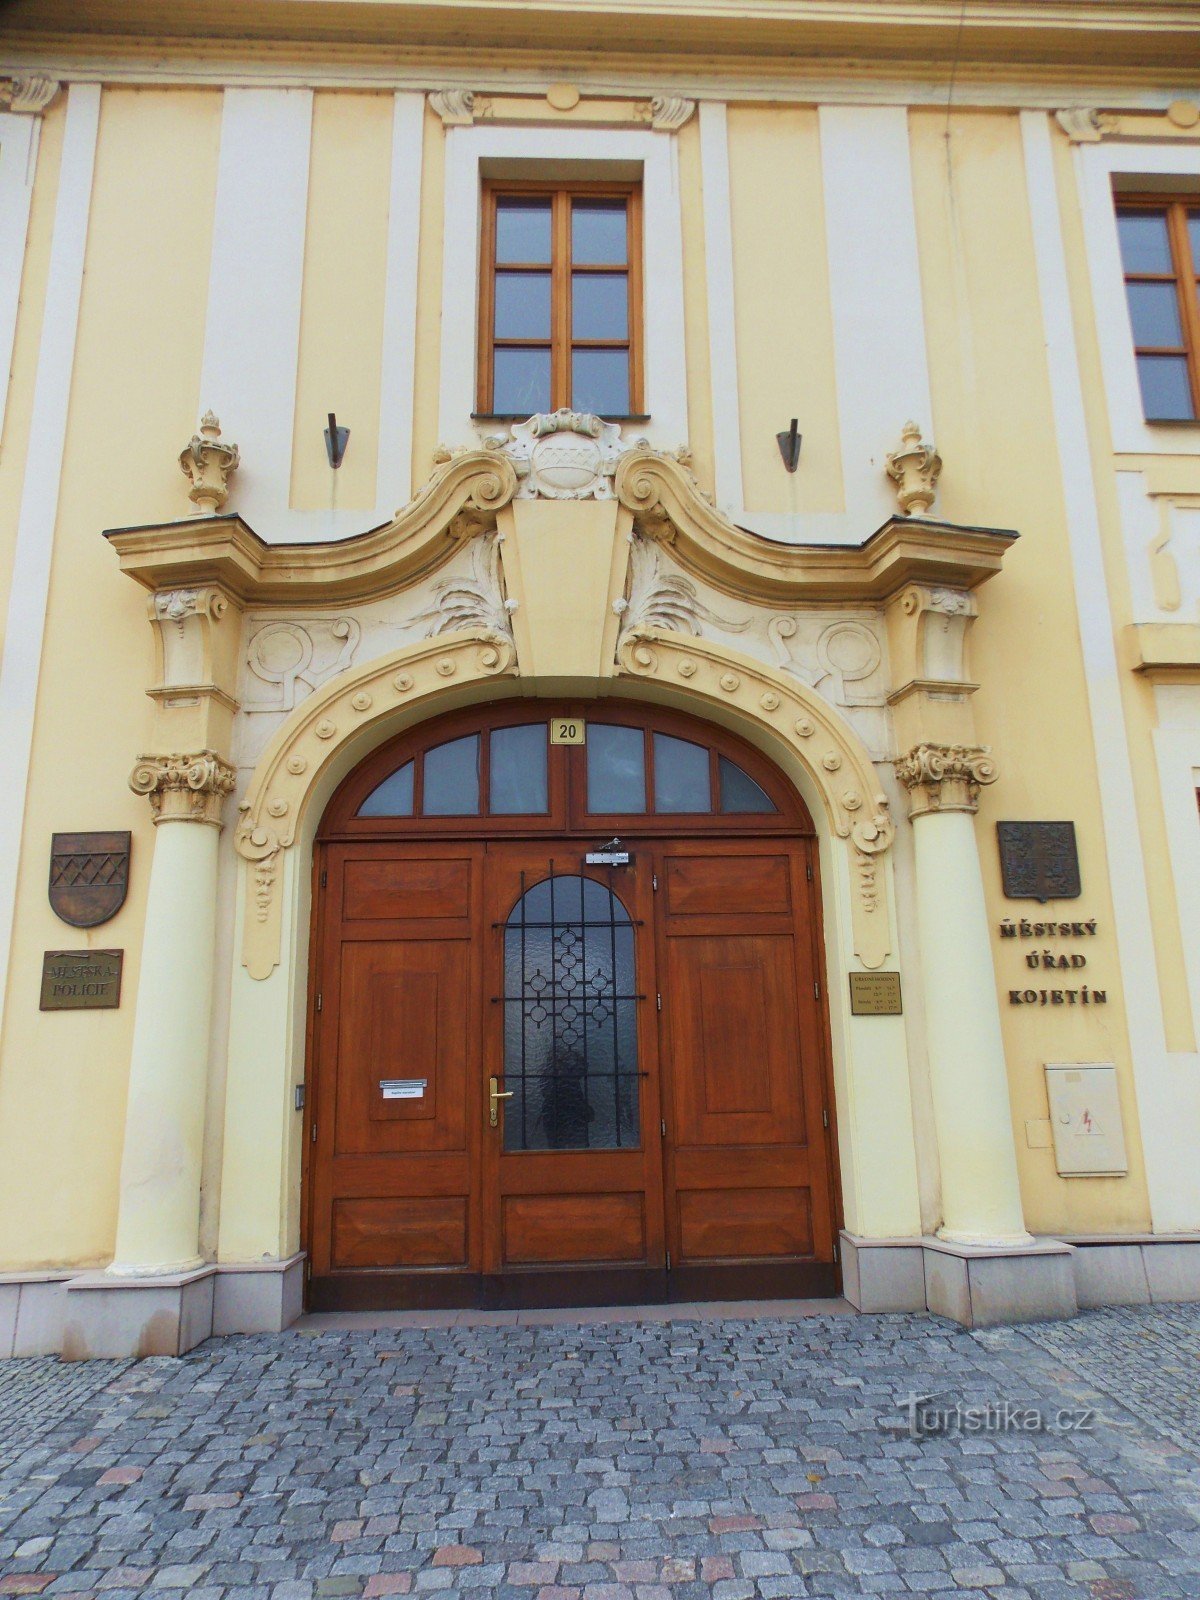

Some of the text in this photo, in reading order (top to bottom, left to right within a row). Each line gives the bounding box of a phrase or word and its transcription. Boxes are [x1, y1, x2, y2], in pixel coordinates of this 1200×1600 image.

[559, 724, 577, 738] 20
[999, 918, 1098, 938] MĚSTSKÝ
[1025, 949, 1087, 969] ÚŘAD
[53, 983, 109, 996] POLICIE
[1008, 985, 1107, 1006] KOJETÍN
